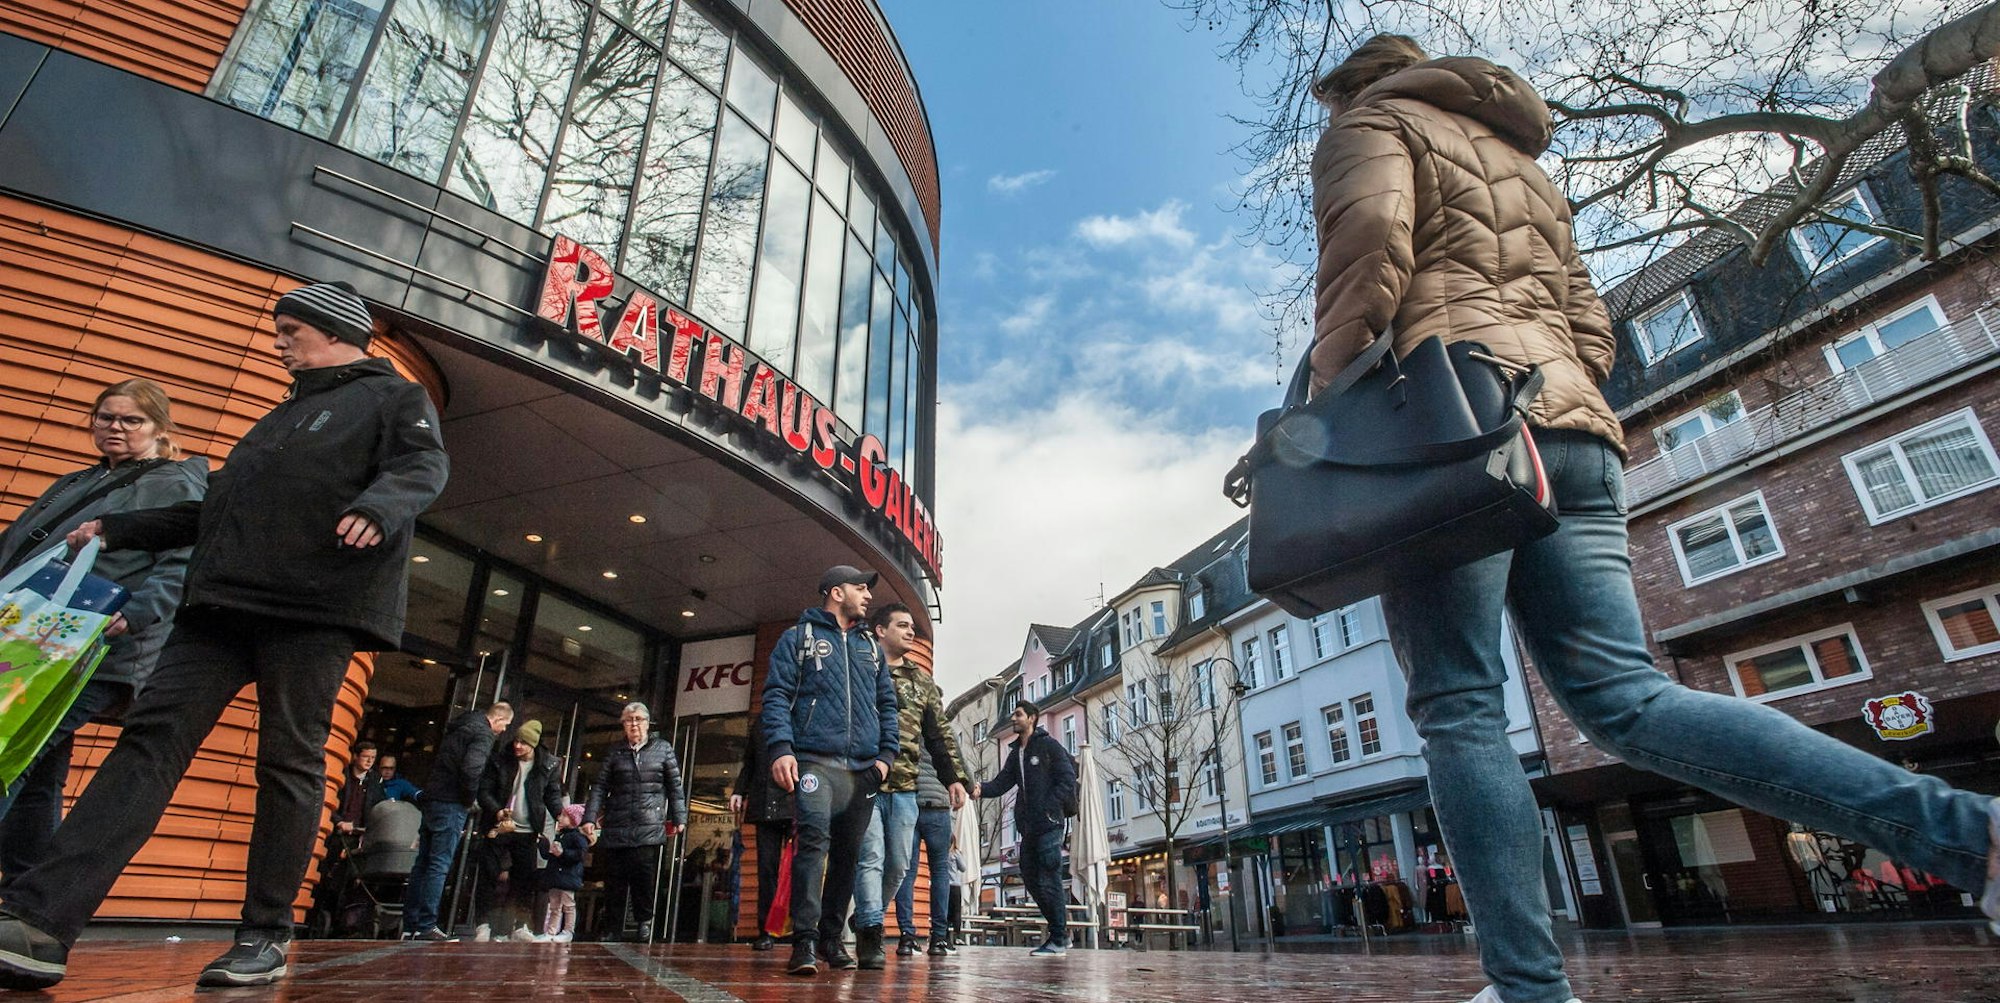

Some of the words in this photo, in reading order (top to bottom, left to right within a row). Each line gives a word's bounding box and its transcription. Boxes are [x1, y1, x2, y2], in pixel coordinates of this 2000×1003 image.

[683, 661, 754, 692] KFC
[1886, 713, 1911, 722] BAYER
[700, 815, 732, 824] CHICKEN
